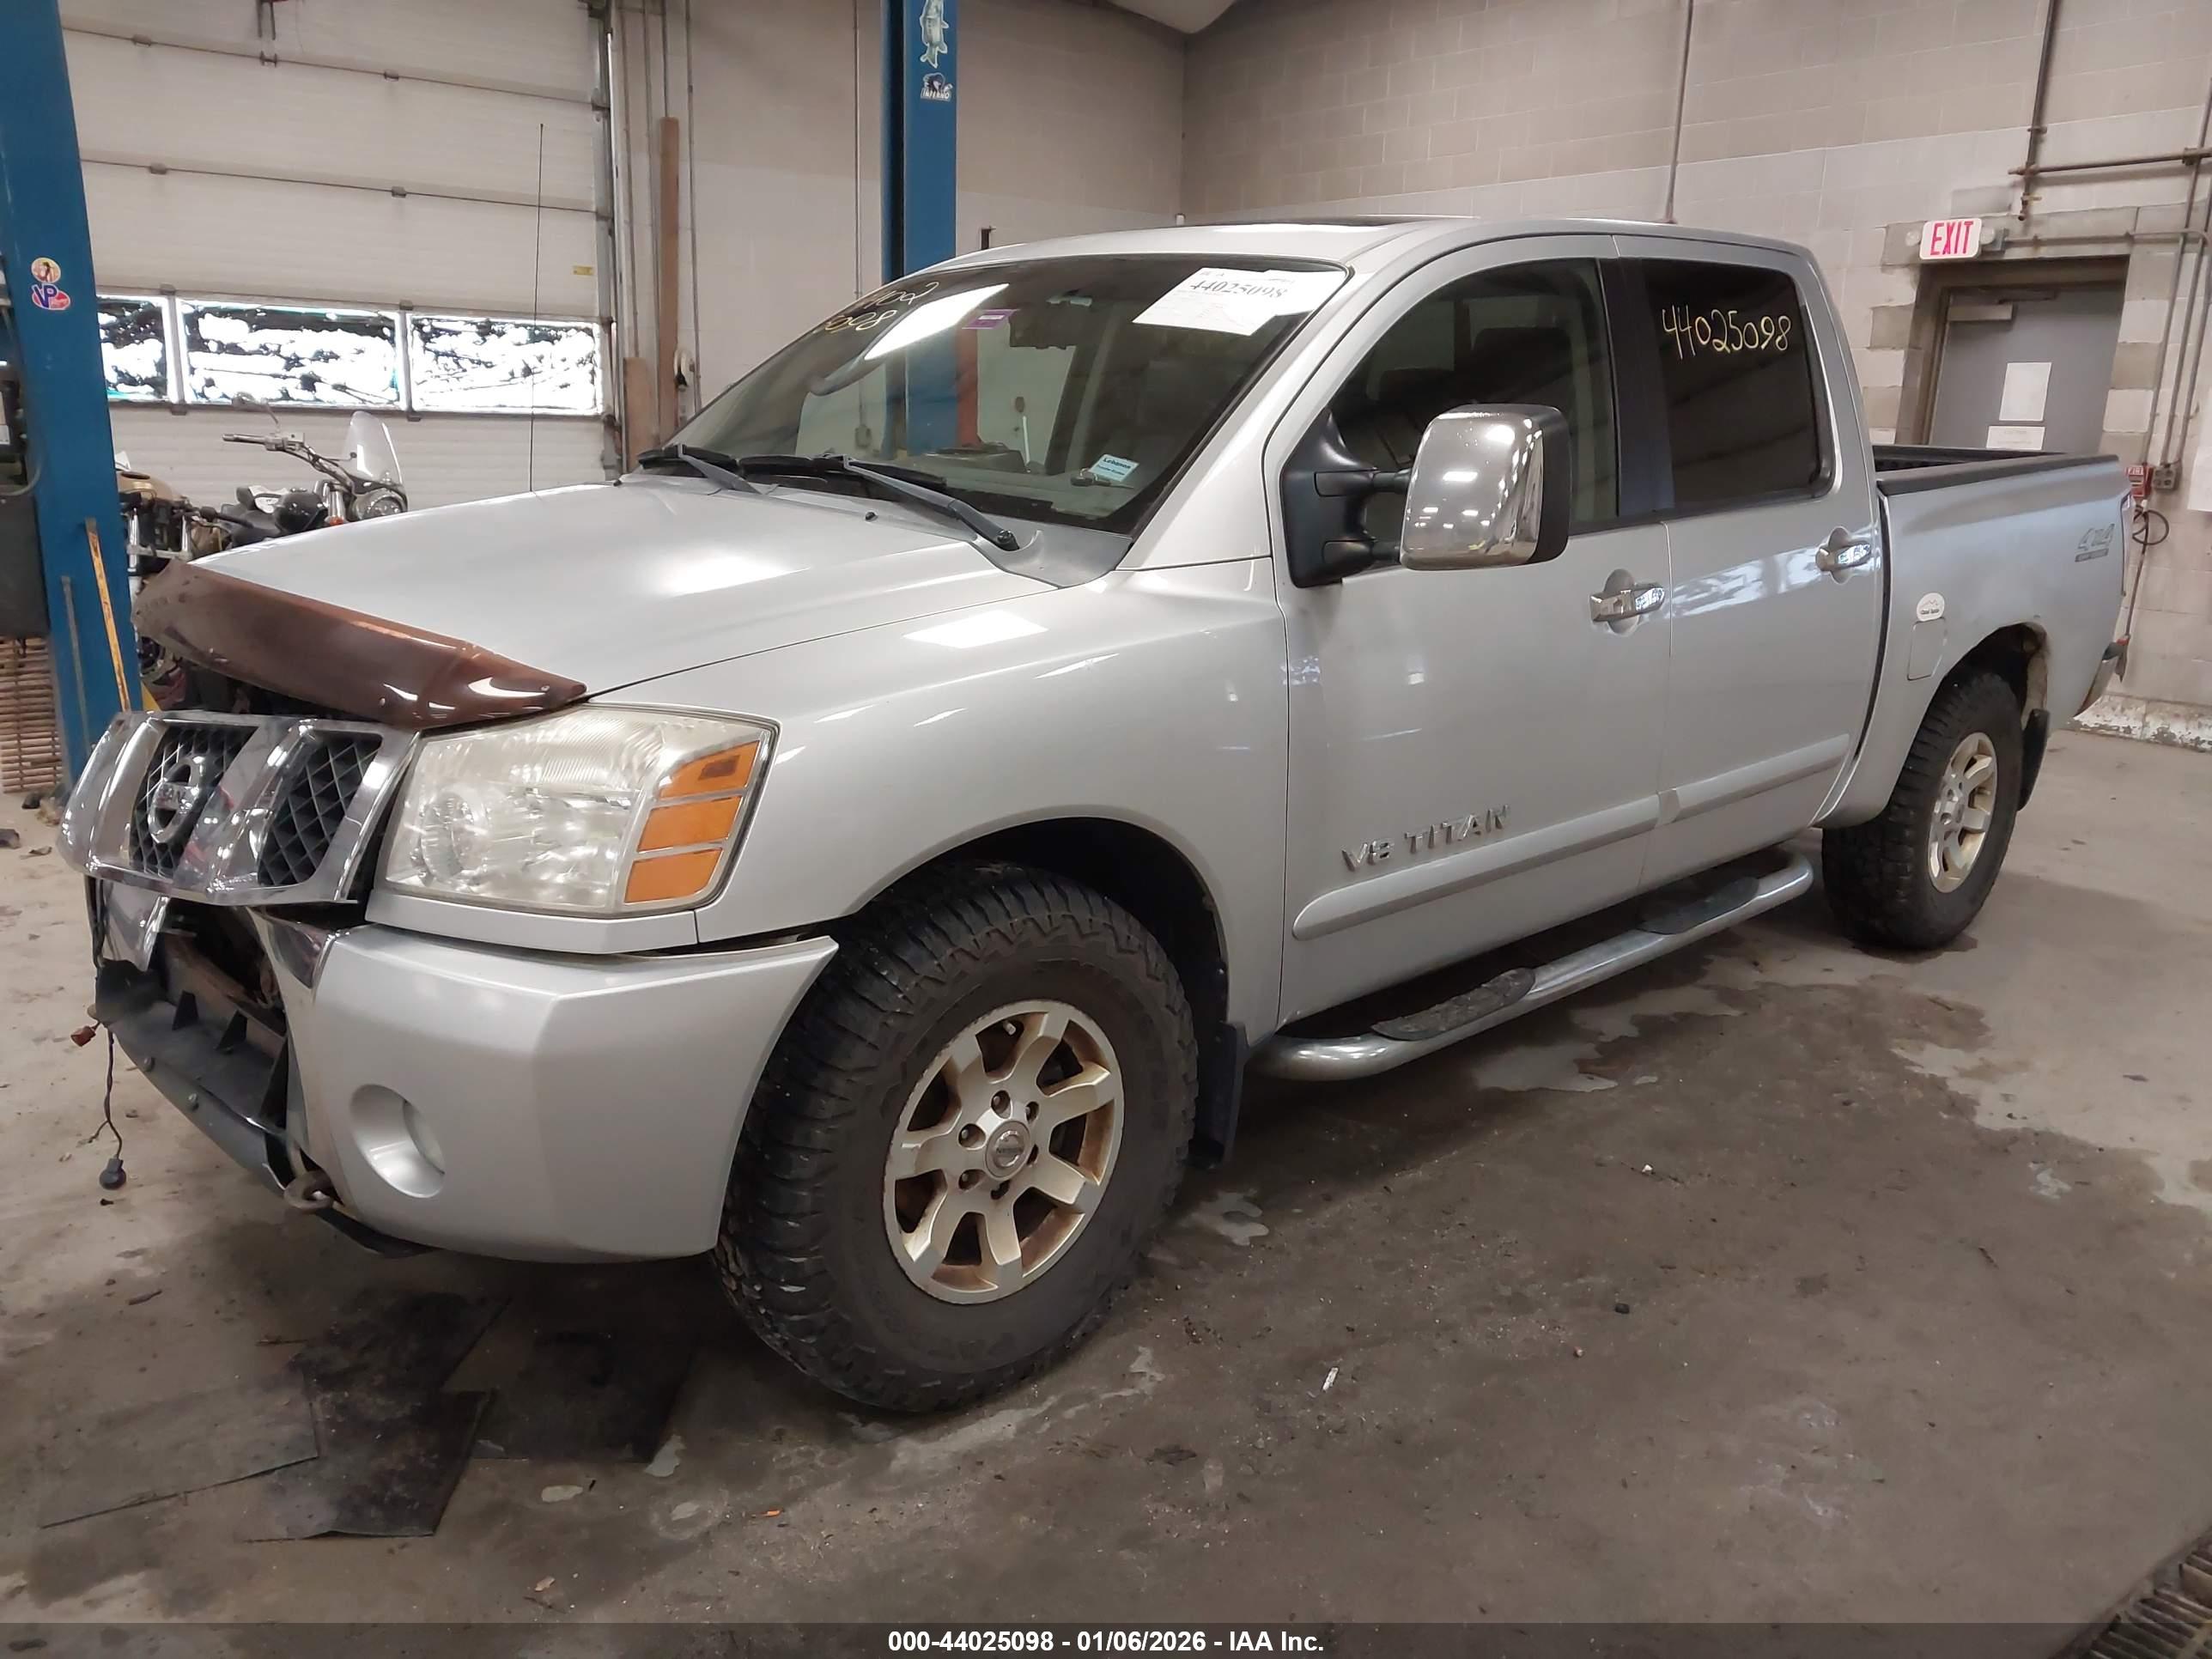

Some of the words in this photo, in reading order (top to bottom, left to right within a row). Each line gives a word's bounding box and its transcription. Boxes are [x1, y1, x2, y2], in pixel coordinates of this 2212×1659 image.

[1929, 221, 1974, 256] EXIT
[1189, 279, 1288, 298] 44025098
[1662, 304, 1791, 360] 44025098
[1340, 840, 1395, 872] V8
[1404, 804, 1509, 854] TITAN
